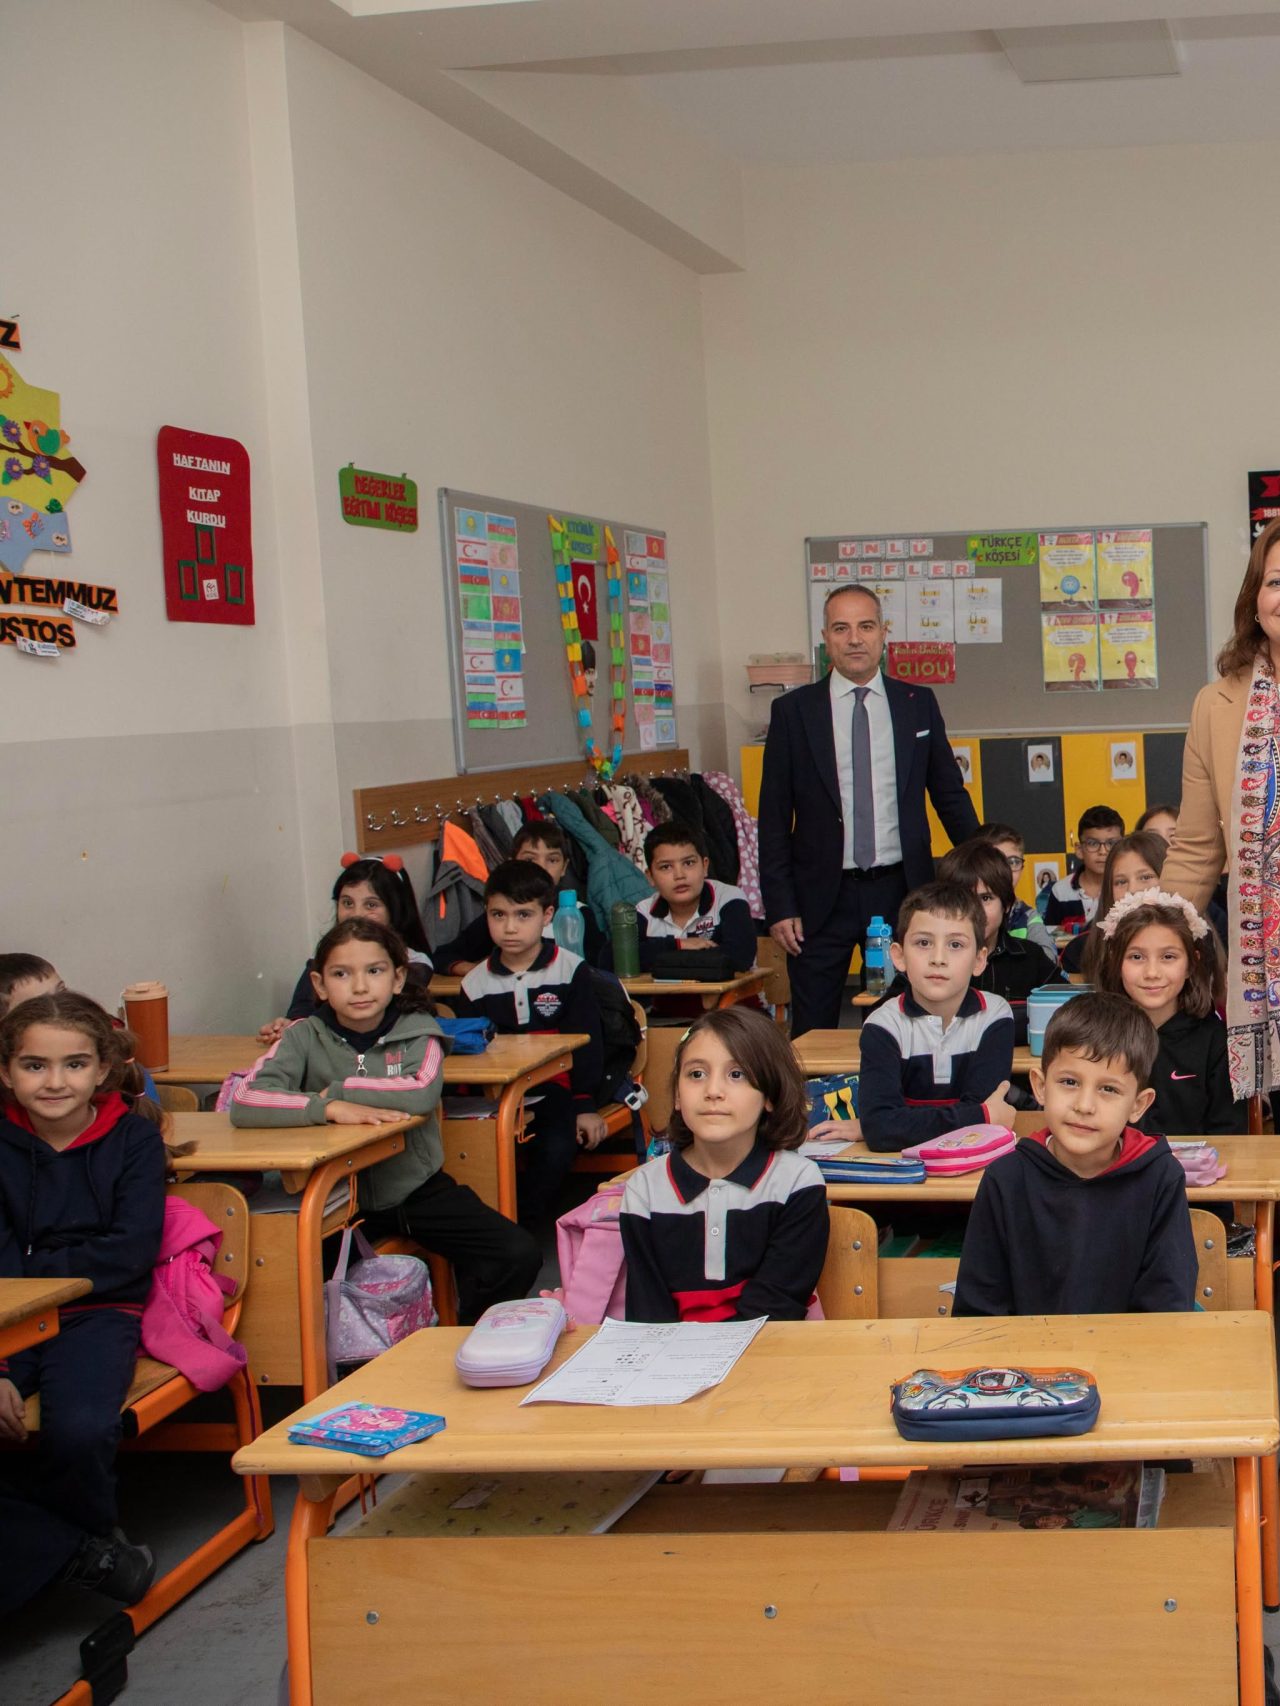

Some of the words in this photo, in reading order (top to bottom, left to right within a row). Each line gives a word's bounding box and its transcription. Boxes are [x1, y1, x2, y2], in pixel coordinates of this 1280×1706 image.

[172, 453, 231, 475] HAFTANIN
[186, 509, 226, 528] KURDU
[1263, 508, 1280, 518] 1881
[840, 541, 928, 557] ÜNLÜ
[980, 535, 1022, 549] TÜRKÇE
[985, 550, 1020, 564] KÖŞESİ
[812, 564, 970, 577] HARFLER
[13, 577, 118, 612] TEMMUZ
